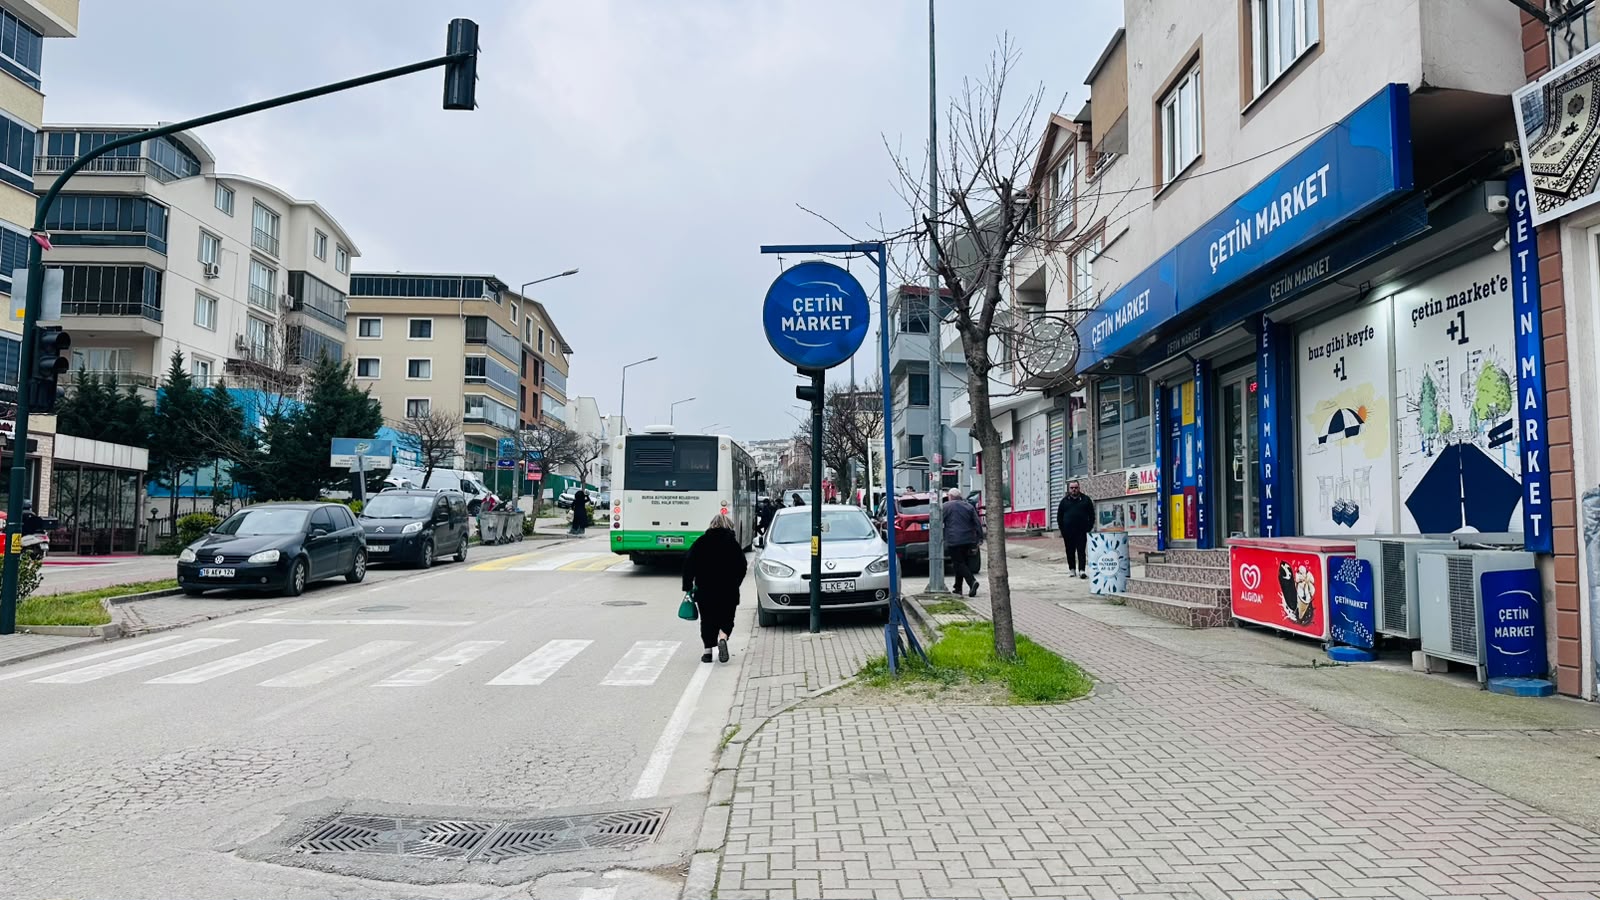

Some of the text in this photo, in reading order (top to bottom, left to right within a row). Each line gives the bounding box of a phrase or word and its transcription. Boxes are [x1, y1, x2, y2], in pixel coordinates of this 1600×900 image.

[1209, 163, 1330, 274] ÇETİN MARKET
[1269, 255, 1330, 303] ÇETİN MARKET
[792, 293, 844, 317] ÇETİN
[1411, 274, 1508, 327] çetin market'e
[781, 315, 852, 332] MARKET
[1092, 288, 1150, 351] ÇETİN MARKET
[1181, 327, 1201, 347] MARKET
[1446, 310, 1469, 346] +1
[1308, 324, 1375, 361] buz gibi keyfe
[1333, 356, 1347, 382] +1
[1515, 188, 1542, 537] ÇETİN MARKET
[1262, 312, 1273, 538] ÇETİN MARKET
[825, 582, 842, 590] LKE
[844, 581, 854, 590] 24
[1494, 626, 1535, 638] MARKET
[1498, 605, 1529, 623] ÇETİN
